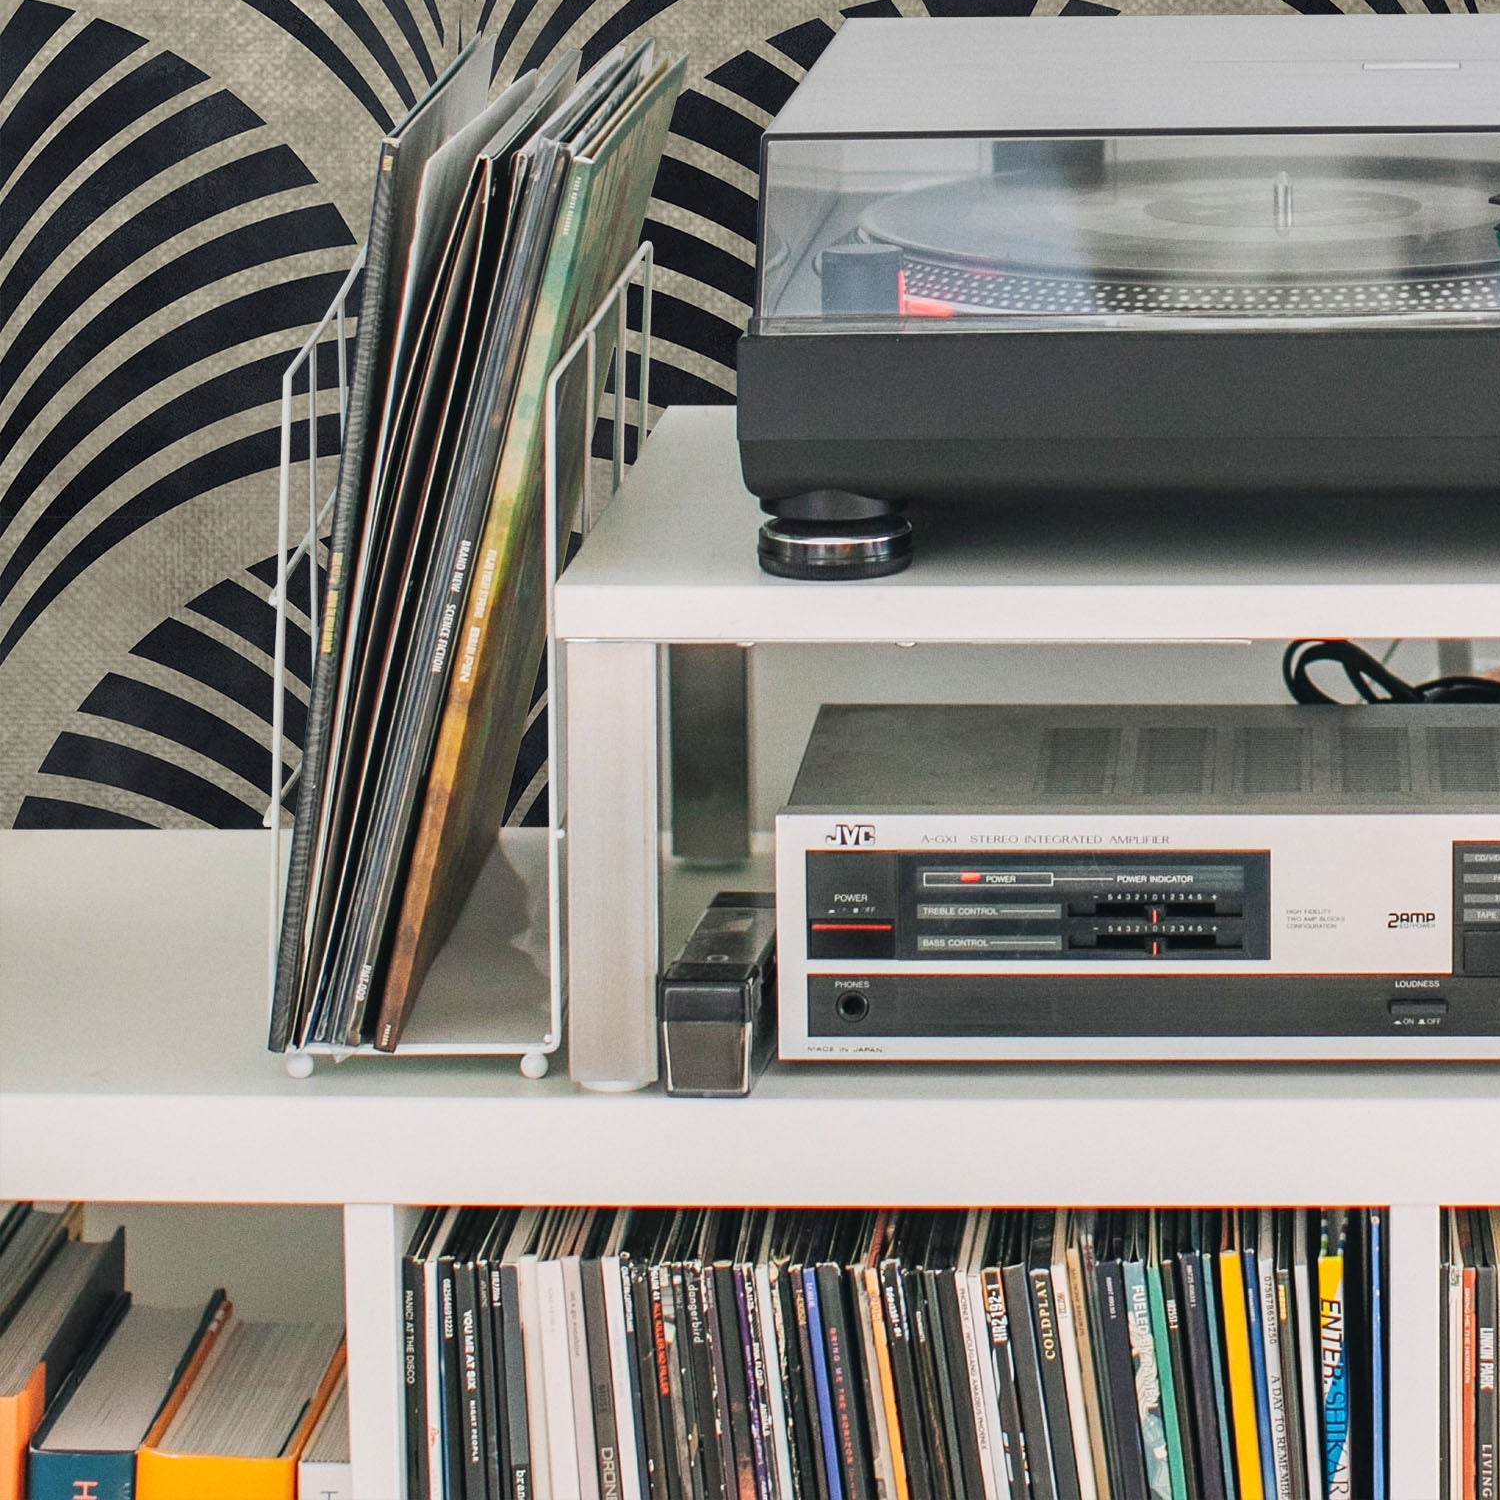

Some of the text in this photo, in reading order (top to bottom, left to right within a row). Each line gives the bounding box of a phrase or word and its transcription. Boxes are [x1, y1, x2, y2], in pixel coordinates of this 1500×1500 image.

[432, 539, 472, 672] BRAND NEW SCIENCE FICTION
[825, 824, 876, 846] JVC
[970, 835, 1019, 844] STEREO
[1024, 835, 1103, 844] INTEGRATED
[1110, 835, 1170, 845] AMPLIFIER
[986, 874, 1017, 884] POWER
[1117, 875, 1194, 884] POWER INDICATOR
[834, 894, 868, 903] POWER
[922, 907, 999, 916] TREBLE CONTROL
[1476, 911, 1497, 919] TAPE
[922, 939, 989, 947] BASS CONTROL
[835, 981, 870, 989] PHONES
[1395, 980, 1440, 988] LOUDNESS
[1402, 1017, 1415, 1025] ON
[1426, 1017, 1441, 1025] OFF
[652, 1290, 660, 1301] 41
[653, 1302, 662, 1319] ALL
[688, 1284, 704, 1343] dangerbird
[987, 1284, 1009, 1342] HR2192-1
[1131, 1284, 1149, 1334] FUELED
[1264, 1276, 1277, 1345] 075678651250
[1034, 1280, 1056, 1362] COLDPLAY
[1464, 1314, 1471, 1327] ME
[405, 1290, 416, 1384] PANIC! AT THE DISCO
[654, 1320, 665, 1350] KILLER
[1464, 1329, 1472, 1344] THE
[463, 1310, 476, 1391] YOU ME AT SIX
[657, 1350, 666, 1364] NO
[1479, 1327, 1495, 1391] LINKIN PARK
[959, 1288, 988, 1451] PHOENIX WOLFGANG AMADEUS PHOENIX
[1464, 1346, 1472, 1385] HORIZON
[659, 1364, 670, 1396] FILLER
[1270, 1375, 1281, 1384] A
[830, 1327, 853, 1464] BRING ME THE HORIZON
[1271, 1388, 1284, 1412] DAY
[469, 1400, 480, 1464] NIGHT PEOPLE
[1274, 1416, 1285, 1433] TO
[1482, 1444, 1493, 1499] LIVING
